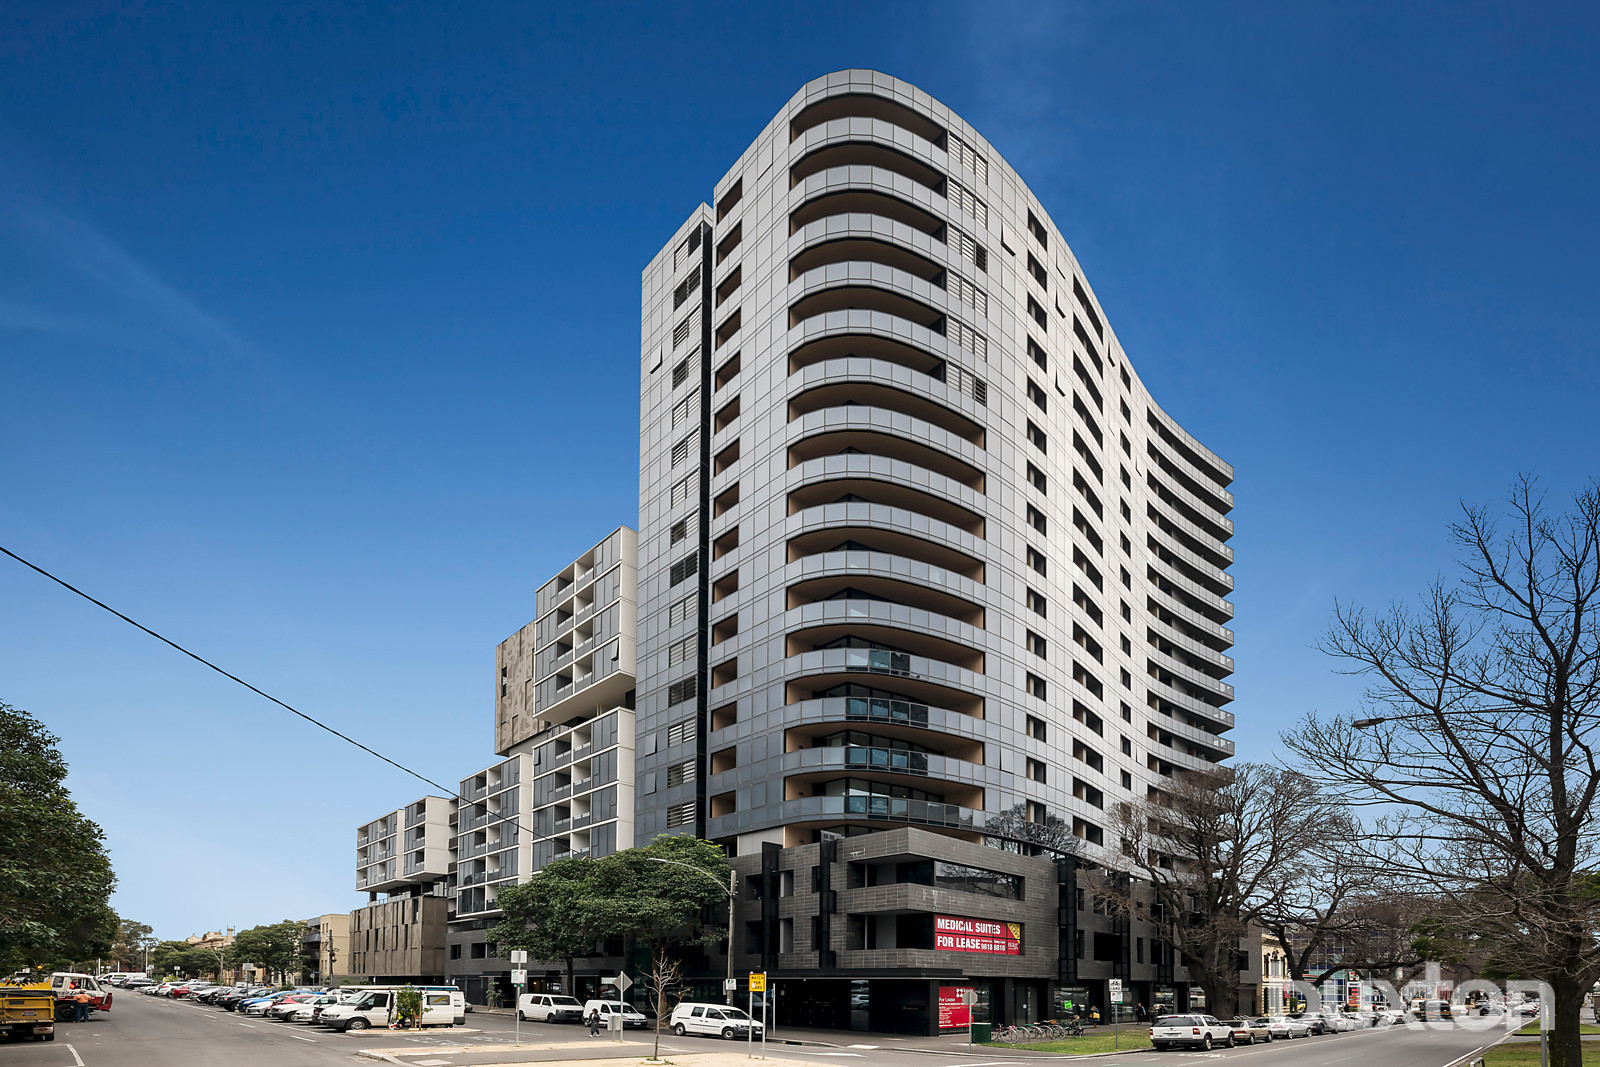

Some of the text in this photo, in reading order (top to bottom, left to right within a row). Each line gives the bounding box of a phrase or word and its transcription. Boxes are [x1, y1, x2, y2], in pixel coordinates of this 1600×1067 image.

[937, 918, 1000, 935] MEDICAL SUITES
[937, 936, 980, 949] FOR LEASE
